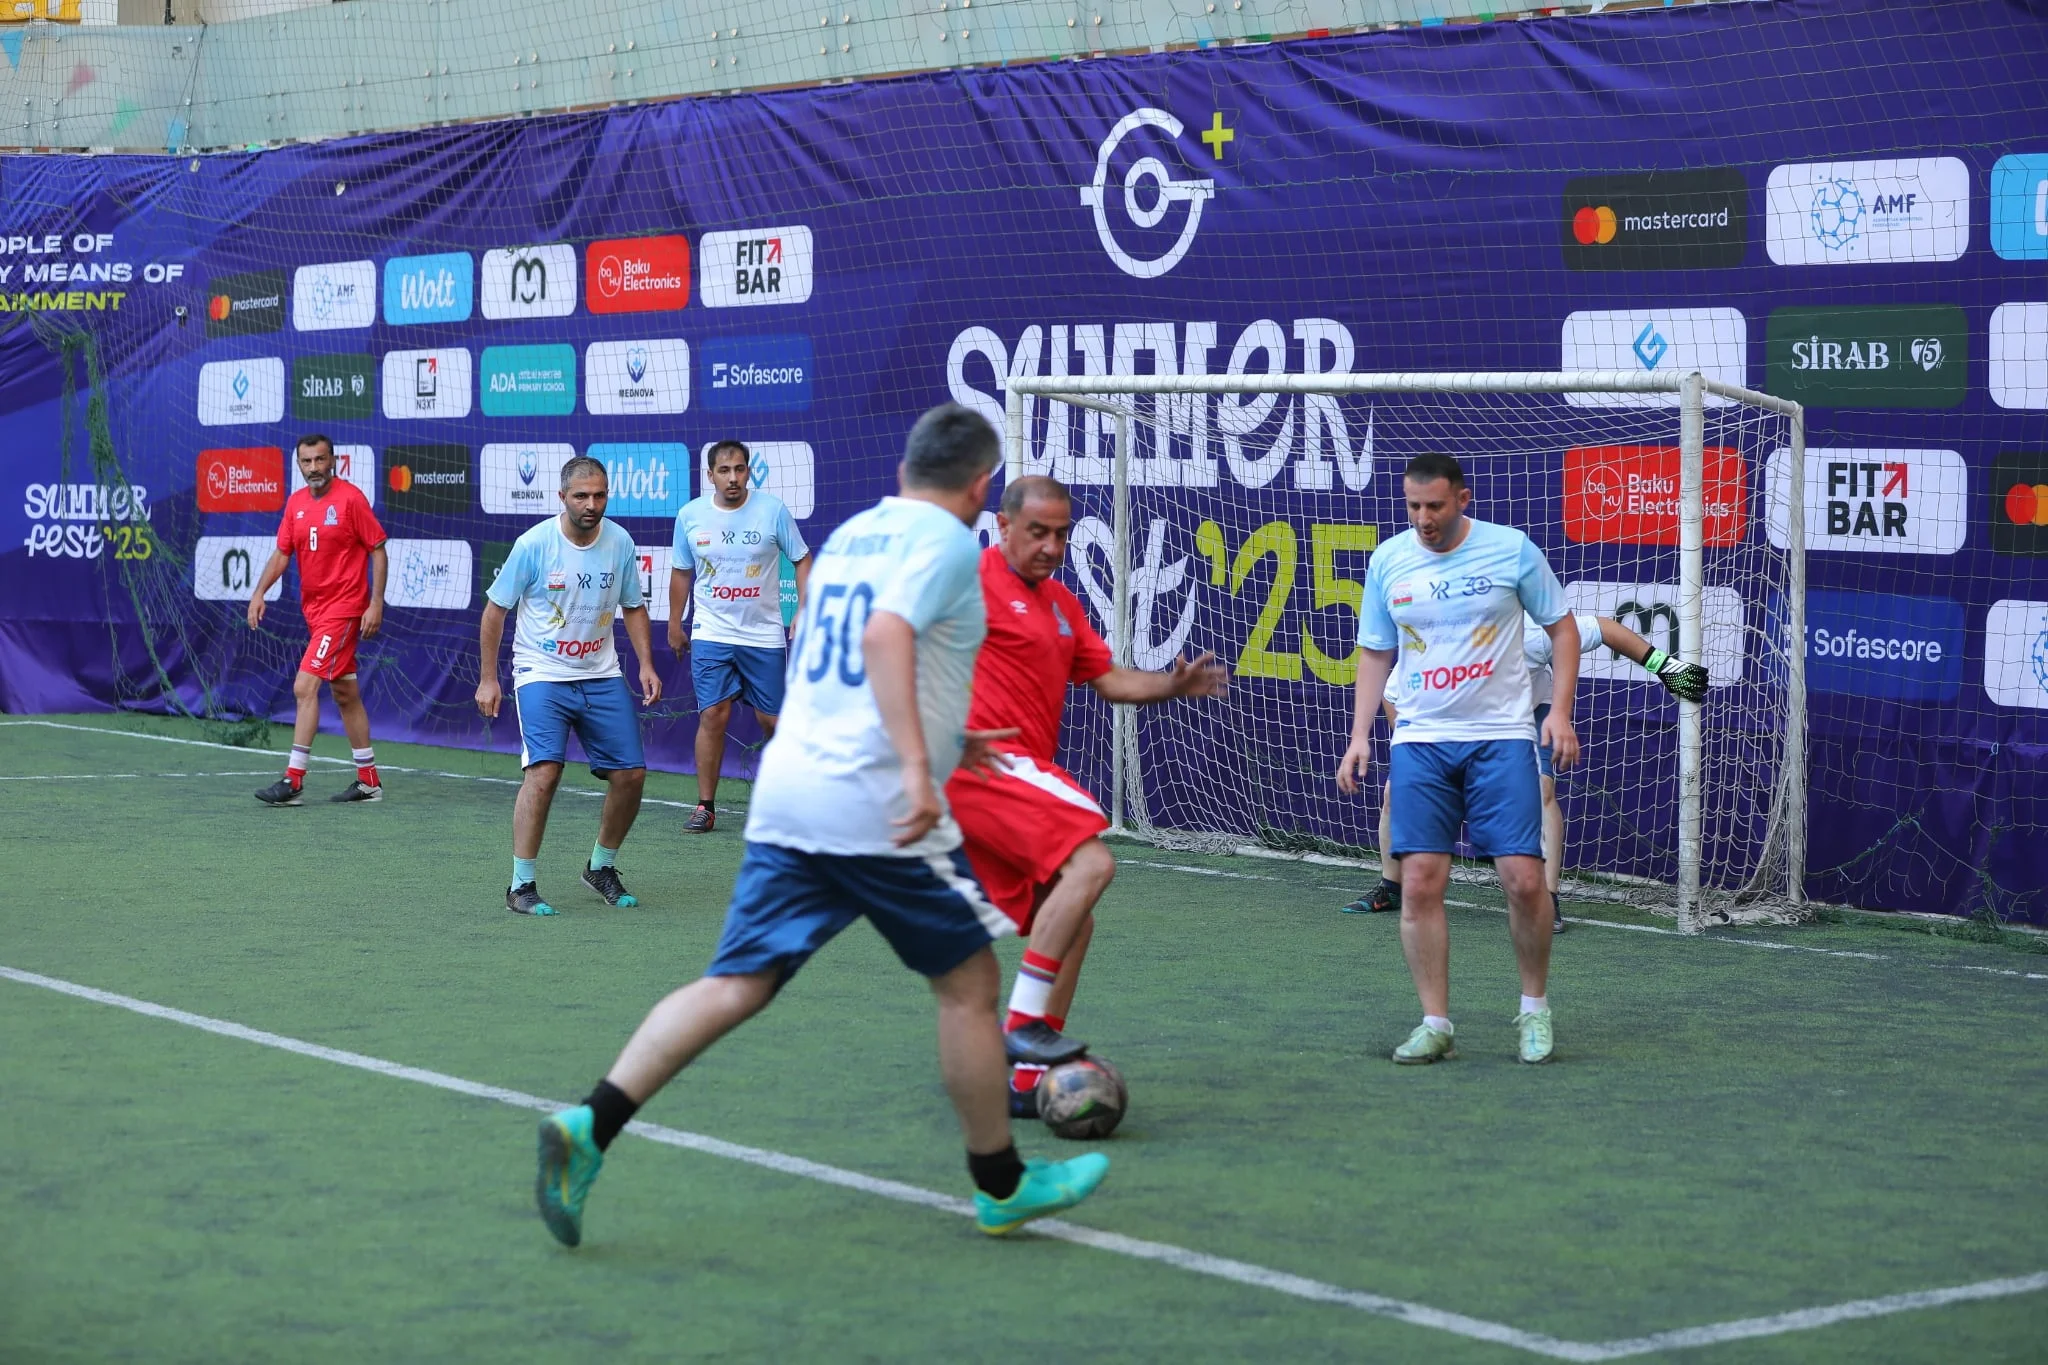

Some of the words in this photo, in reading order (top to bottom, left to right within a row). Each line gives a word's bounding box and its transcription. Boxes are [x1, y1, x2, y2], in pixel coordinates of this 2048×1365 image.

[1873, 193, 1916, 214] AMF
[1625, 207, 1728, 231] mastercard
[73, 234, 114, 253] OF
[736, 239, 767, 266] FIT
[24, 263, 132, 282] MEANS
[143, 264, 184, 283] OF
[623, 260, 651, 274] Baku
[337, 284, 355, 297] AMF
[401, 268, 455, 310] Wolt
[623, 273, 681, 291] Electronics
[736, 267, 781, 294] BAR
[233, 294, 279, 311] mastercard
[1791, 335, 1890, 370] SİRAB
[489, 372, 517, 392] ADA
[730, 363, 803, 385] Sofascore
[618, 388, 654, 398] MEDNOVA
[229, 466, 252, 480] Baku
[414, 470, 465, 484] mastercard
[1628, 473, 1674, 494] Baku
[1827, 462, 1882, 498] FIT
[229, 478, 278, 494] Electronics
[511, 490, 544, 500] MEDNOVA
[1628, 495, 1730, 517] Electrics
[1827, 500, 1908, 537] BAR
[309, 526, 318, 551] 5
[316, 635, 332, 659] 5
[1814, 629, 1942, 663] Sofascore
